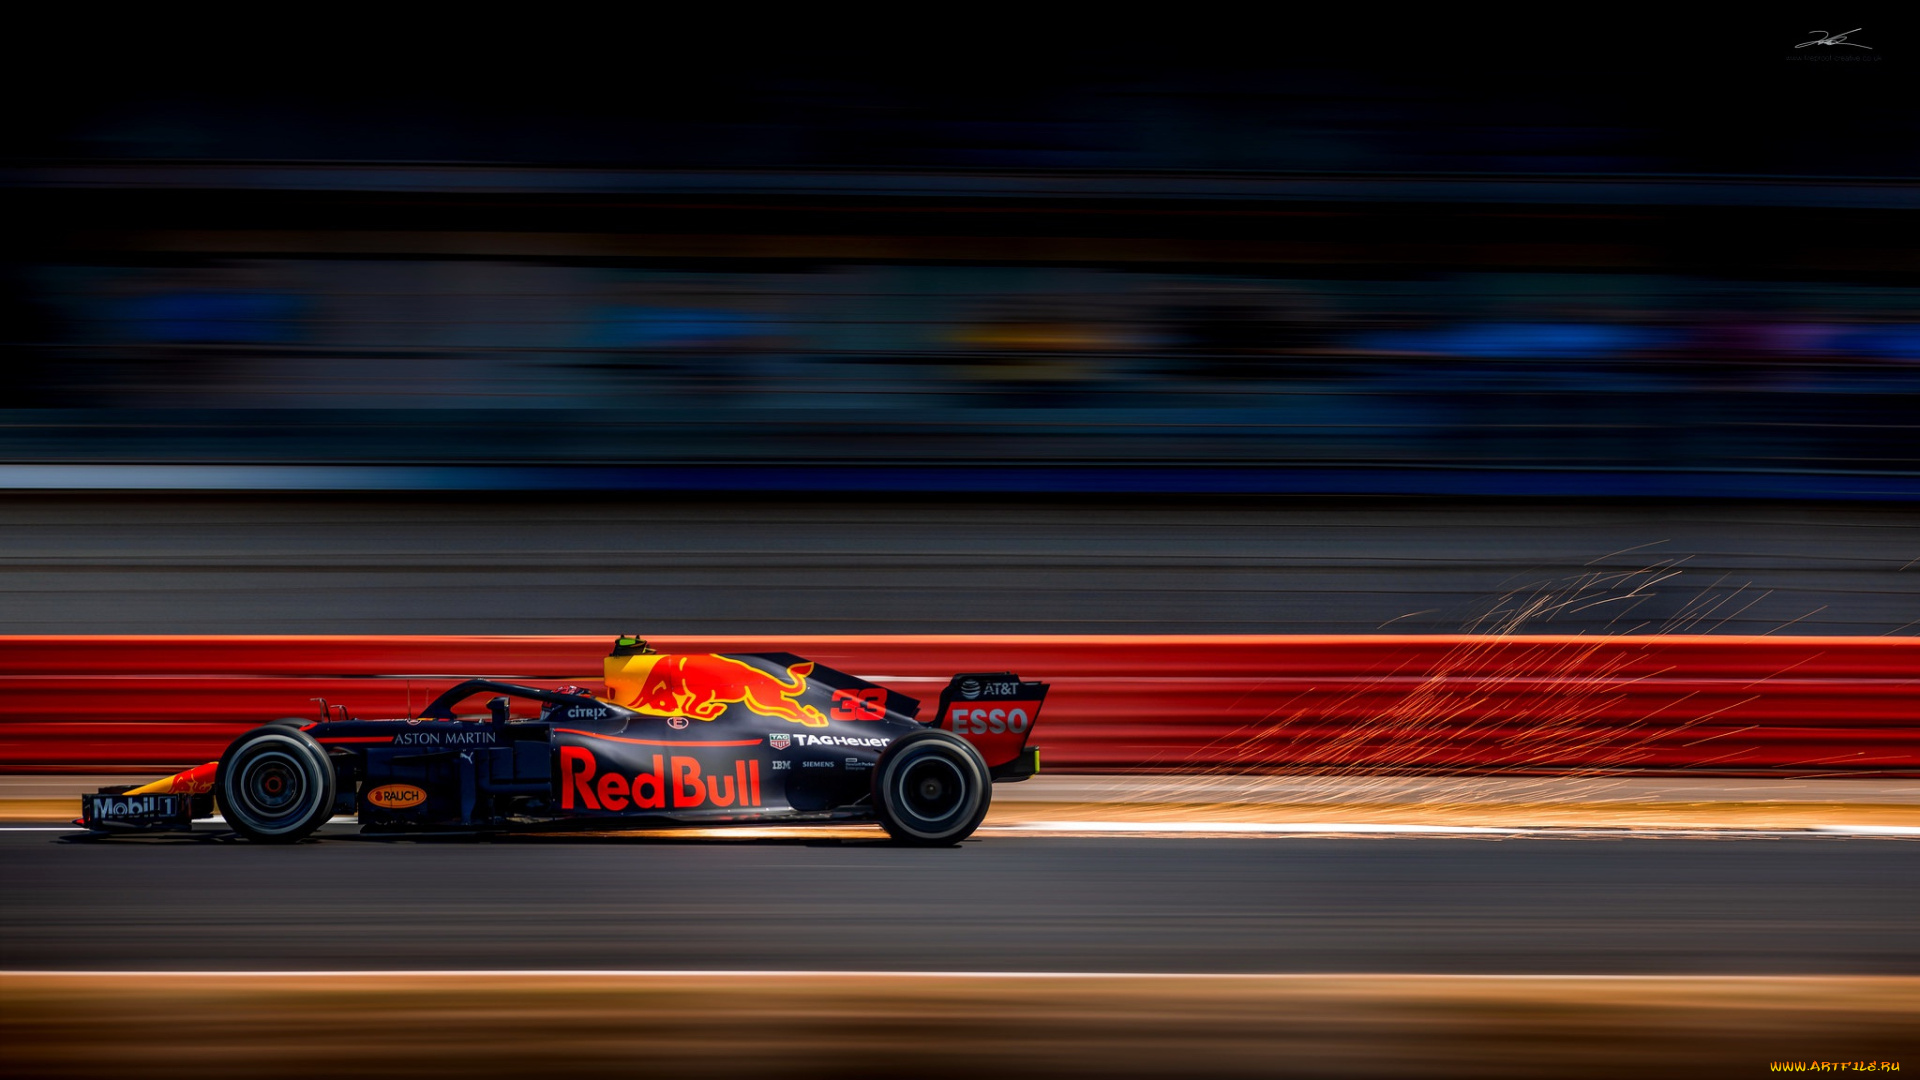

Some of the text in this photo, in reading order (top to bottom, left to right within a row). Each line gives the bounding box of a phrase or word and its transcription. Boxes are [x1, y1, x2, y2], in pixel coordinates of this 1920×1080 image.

[983, 682, 1019, 696] AT&T
[830, 688, 888, 721] 33
[952, 708, 1028, 735] ESSO
[394, 731, 496, 745] ASTON MARTIN
[772, 761, 791, 770] IBM
[560, 745, 761, 811] Red Bull
[383, 791, 419, 801] RAUCH
[93, 796, 155, 820] Mobil
